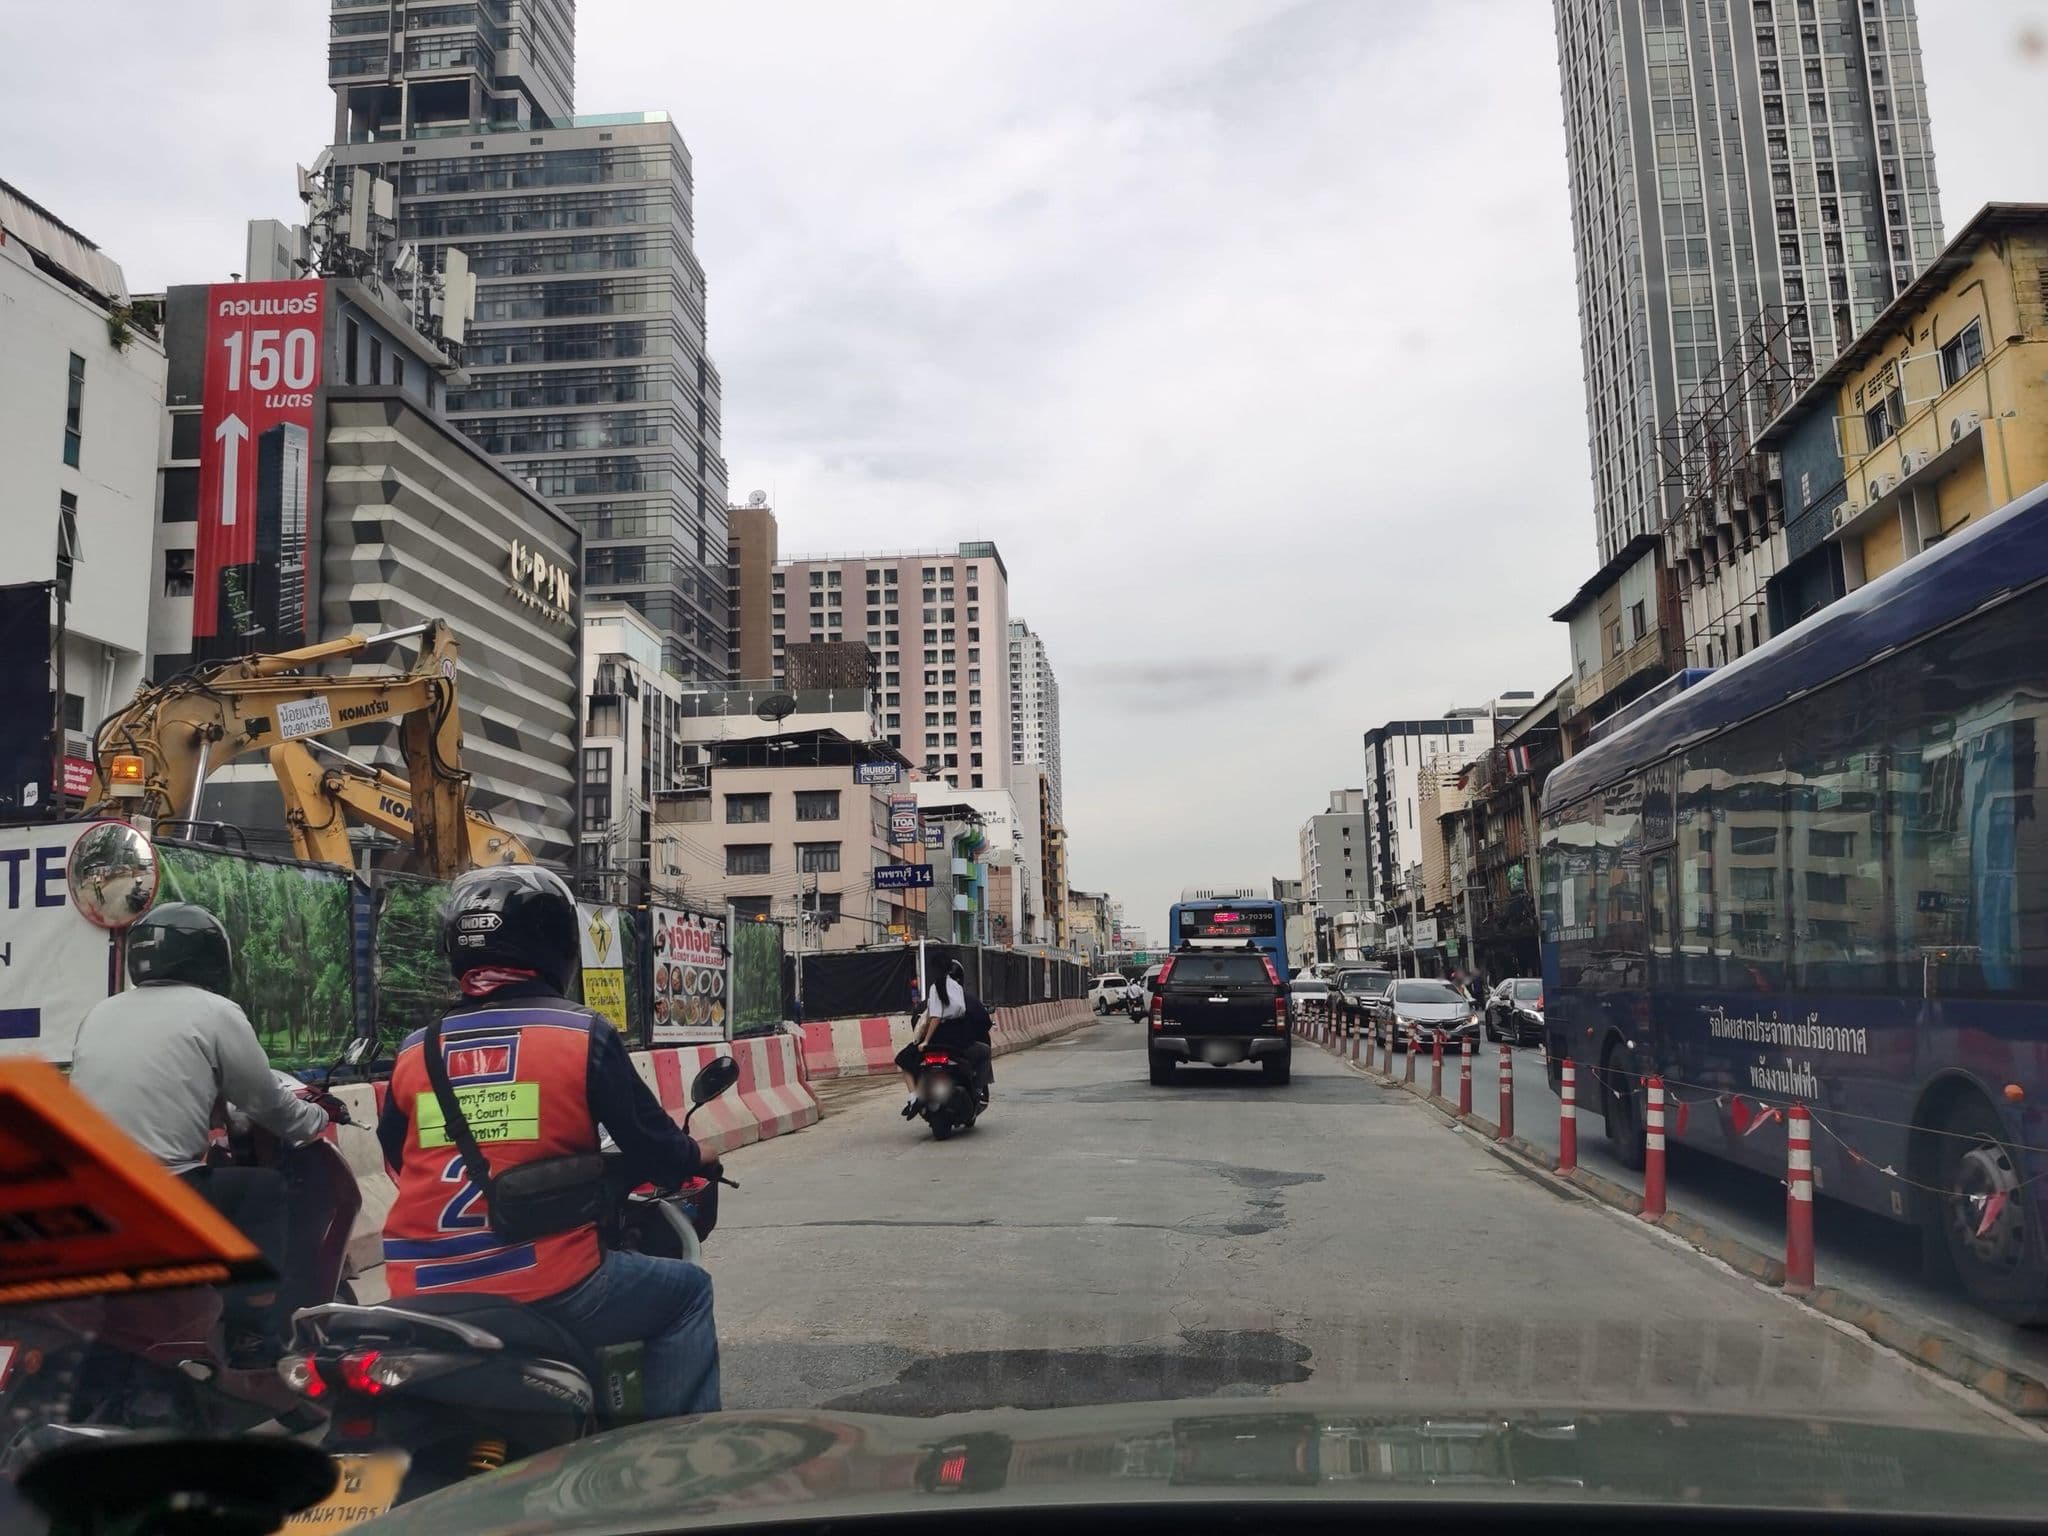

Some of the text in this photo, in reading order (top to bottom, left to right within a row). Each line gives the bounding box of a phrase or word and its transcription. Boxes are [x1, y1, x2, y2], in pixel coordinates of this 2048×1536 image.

[219, 292, 318, 317] คอนเนอร์
[223, 328, 316, 391] 150
[265, 393, 313, 408] เมตร
[338, 700, 389, 722] KOMATSU
[894, 819, 914, 827] TOA
[877, 867, 931, 882] เพชรบุรี 14
[461, 916, 496, 929] INDEX
[1709, 1005, 1867, 1055] รถโดยสารประจำทางปรับอากาศ
[1750, 1055, 1818, 1099] พลังงานไฟฟ้า
[459, 1089, 486, 1108] ชรบุรี
[510, 1090, 516, 1100] 6
